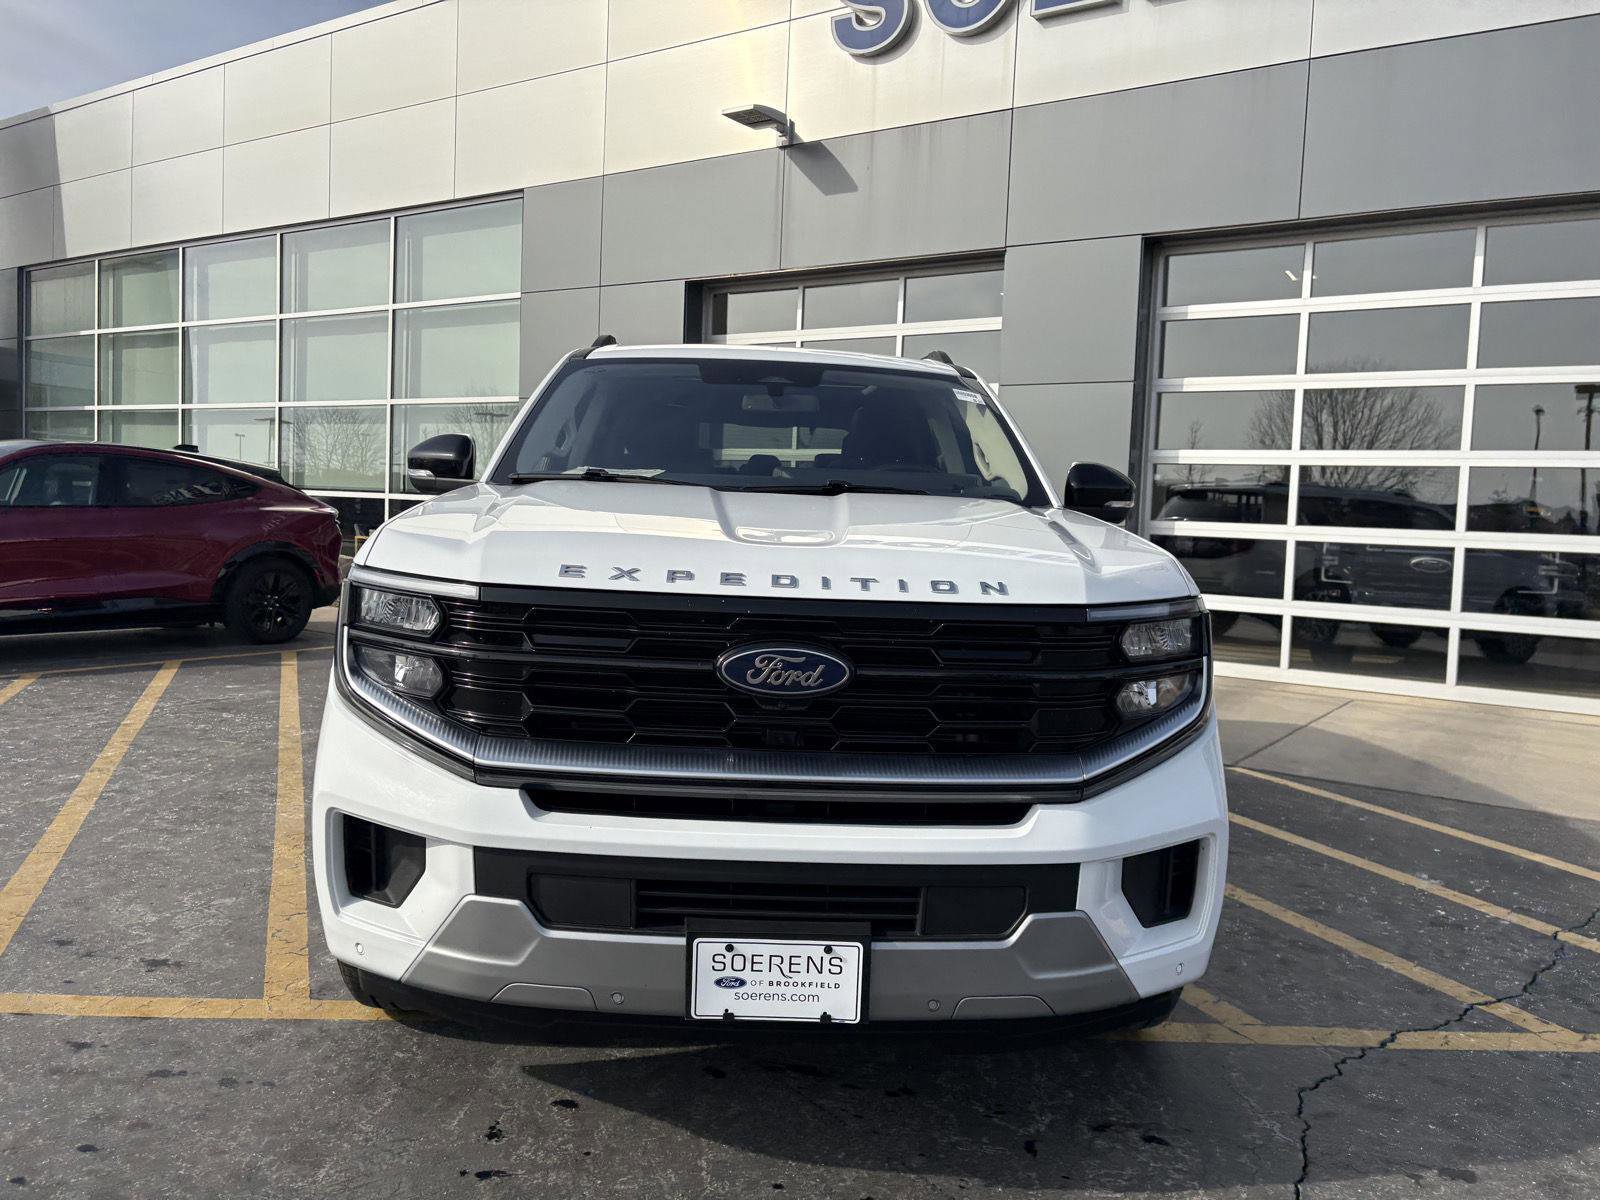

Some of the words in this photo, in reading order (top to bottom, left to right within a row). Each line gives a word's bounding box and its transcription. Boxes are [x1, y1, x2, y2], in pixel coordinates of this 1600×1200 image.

[558, 564, 1009, 596] EXPEDITION
[746, 655, 823, 687] Ford
[712, 953, 843, 979] SOERENS
[734, 992, 820, 1003] soerens.com
[768, 980, 841, 989] BROOKFIELD
